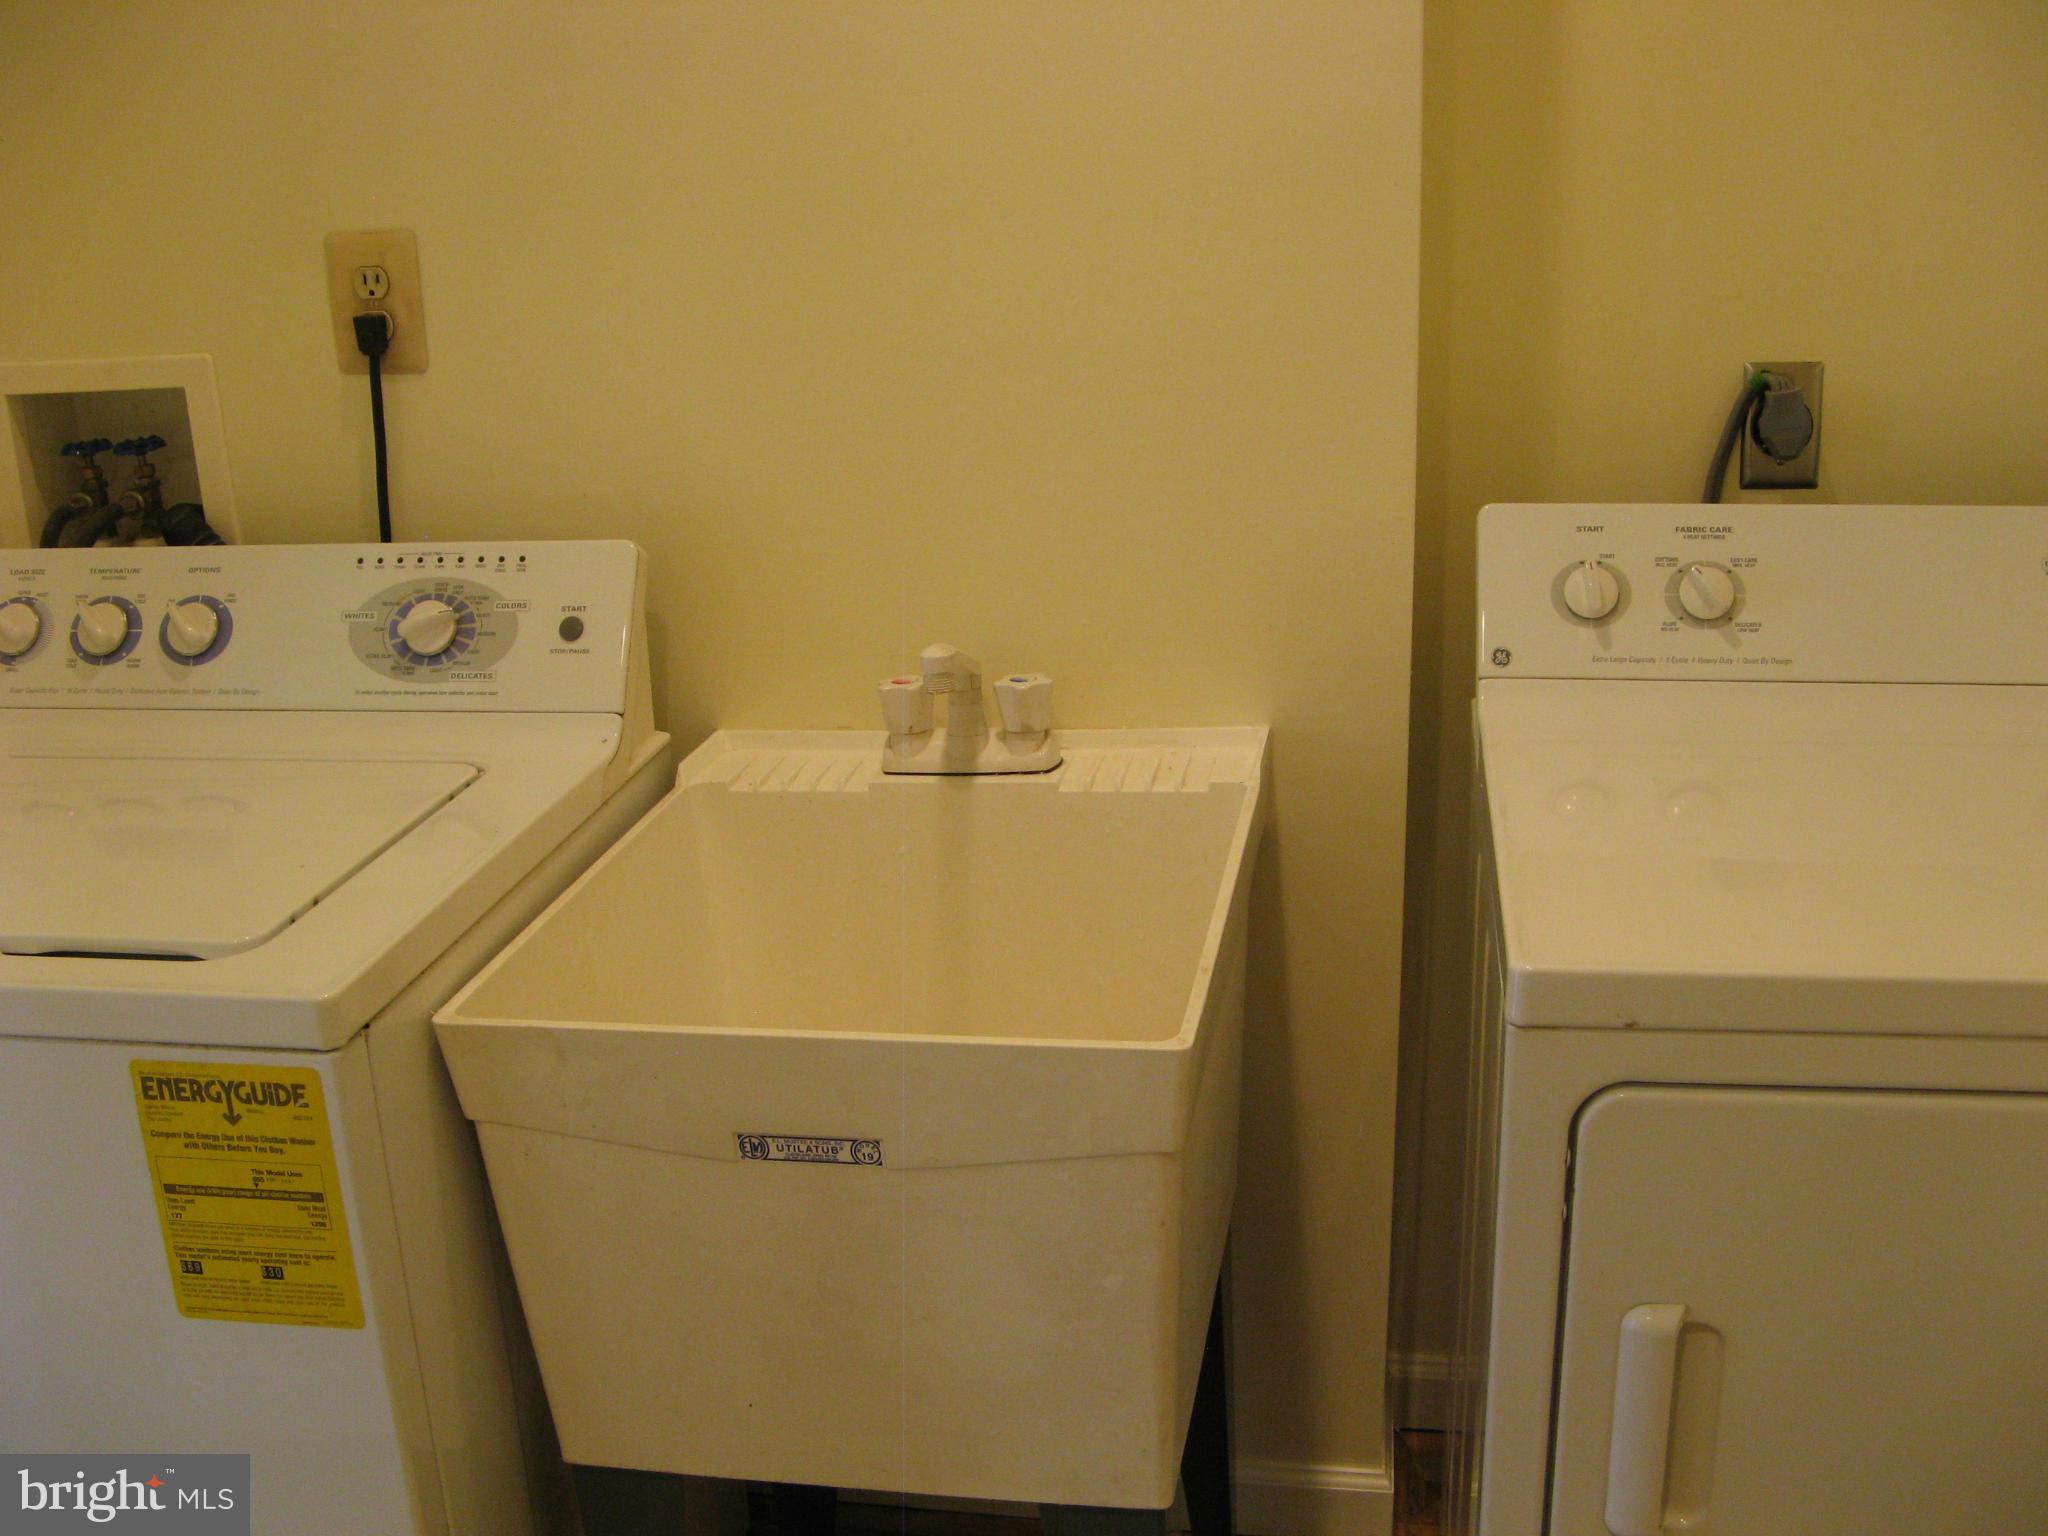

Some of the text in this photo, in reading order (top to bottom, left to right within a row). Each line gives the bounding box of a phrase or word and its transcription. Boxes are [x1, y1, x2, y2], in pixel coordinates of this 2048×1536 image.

[1709, 526, 1734, 534] CARE
[451, 672, 494, 680] DELICATES
[140, 1076, 309, 1109] ENERGYGUIDE
[150, 1130, 182, 1140] Compare
[184, 1130, 195, 1140] the
[196, 1131, 220, 1142] Energy
[184, 1142, 200, 1150] with
[201, 1142, 226, 1152] Others
[227, 1144, 252, 1153] Before
[862, 1152, 874, 1161] 19
